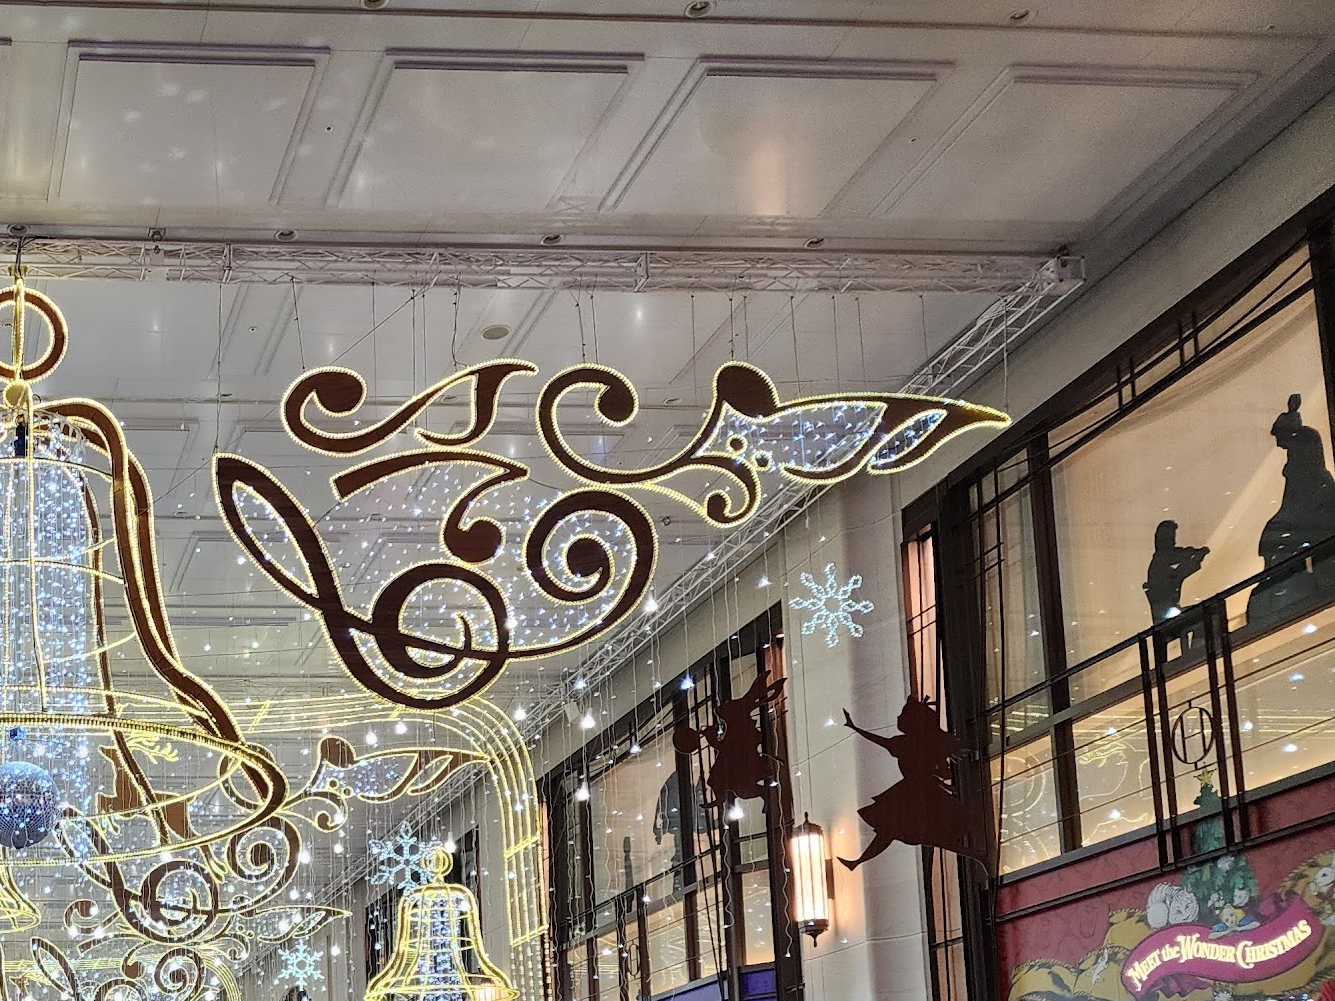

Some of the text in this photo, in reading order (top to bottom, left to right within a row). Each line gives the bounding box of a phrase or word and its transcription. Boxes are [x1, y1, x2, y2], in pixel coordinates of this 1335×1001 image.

[1126, 919, 1312, 991] MEET the WONDER CHRISTMAS
